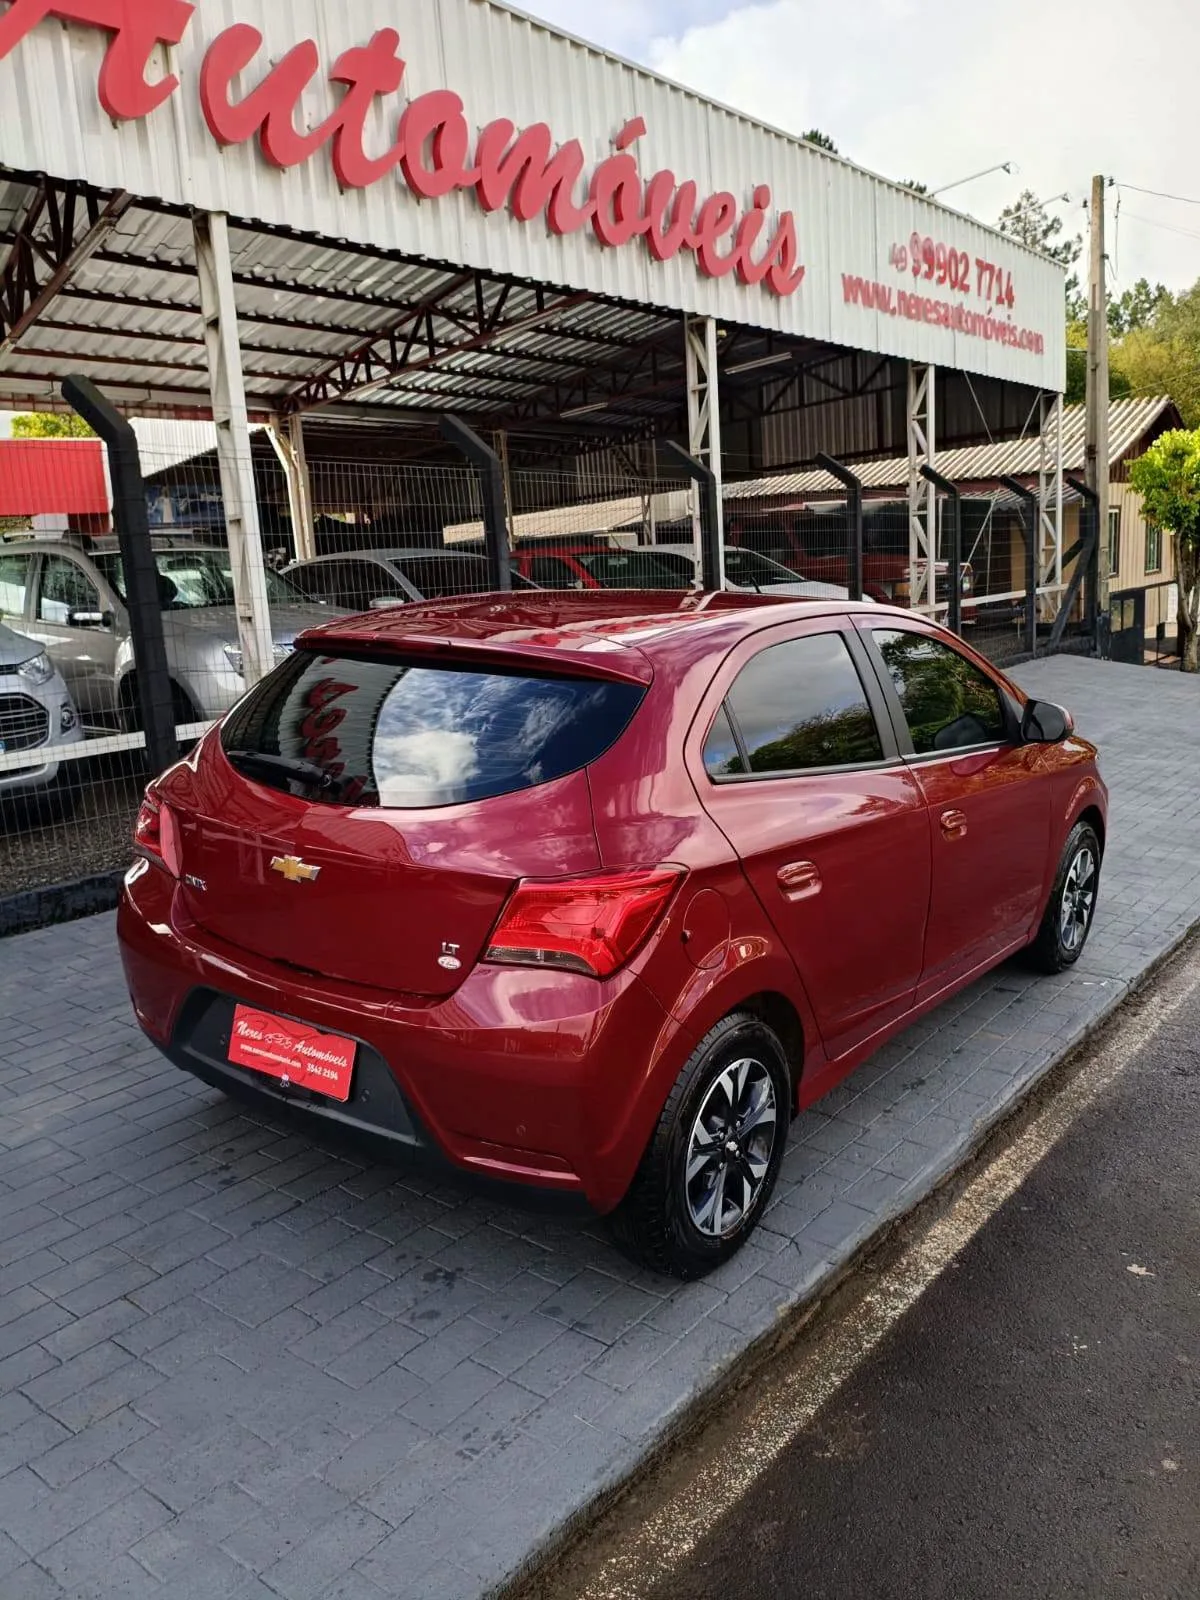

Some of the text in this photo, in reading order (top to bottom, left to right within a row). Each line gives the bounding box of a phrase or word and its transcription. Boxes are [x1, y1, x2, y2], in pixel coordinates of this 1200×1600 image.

[909, 231, 971, 293] 99902
[975, 257, 1015, 309] 7714
[441, 941, 460, 955] LT
